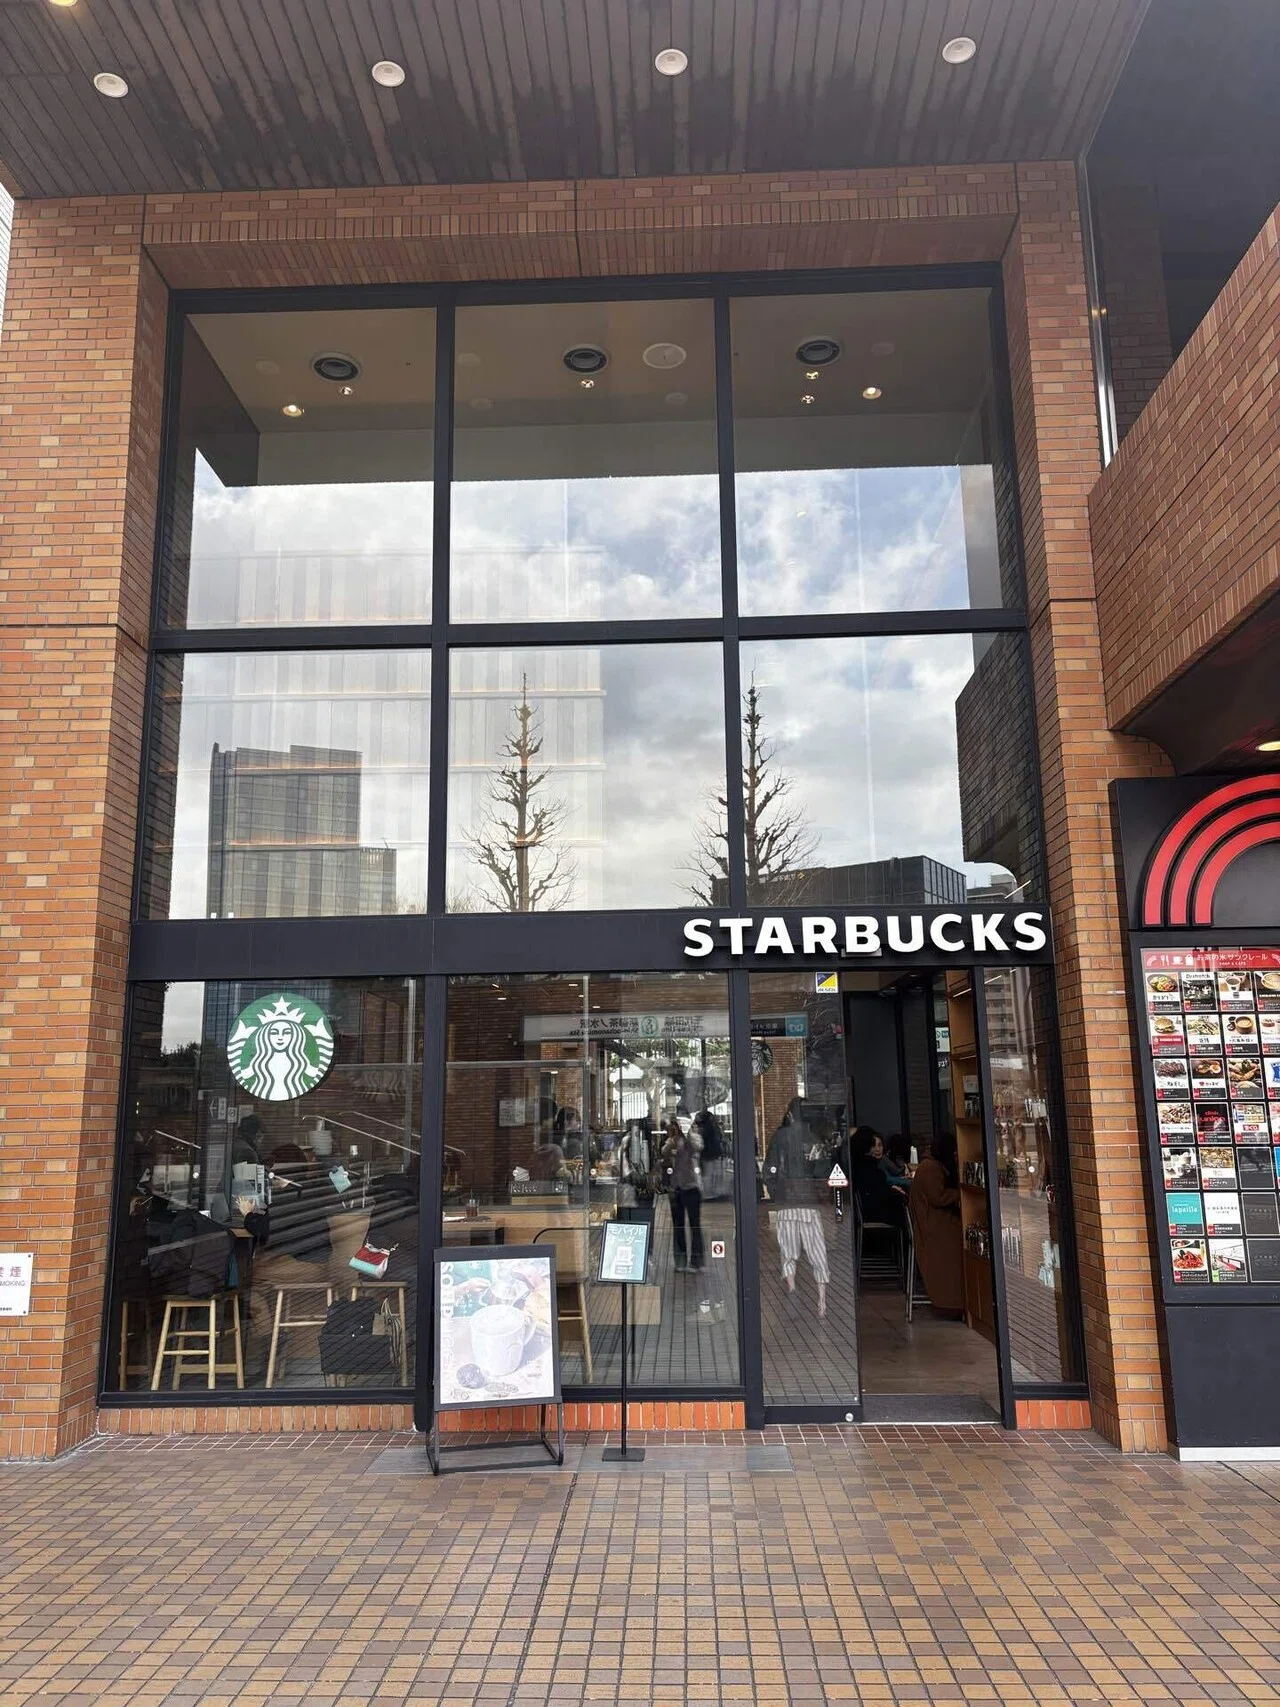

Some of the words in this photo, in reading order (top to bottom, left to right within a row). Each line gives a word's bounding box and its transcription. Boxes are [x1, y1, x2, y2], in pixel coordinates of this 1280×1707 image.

[683, 912, 1047, 957] STARBUCKS
[609, 1226, 644, 1236] モバイル
